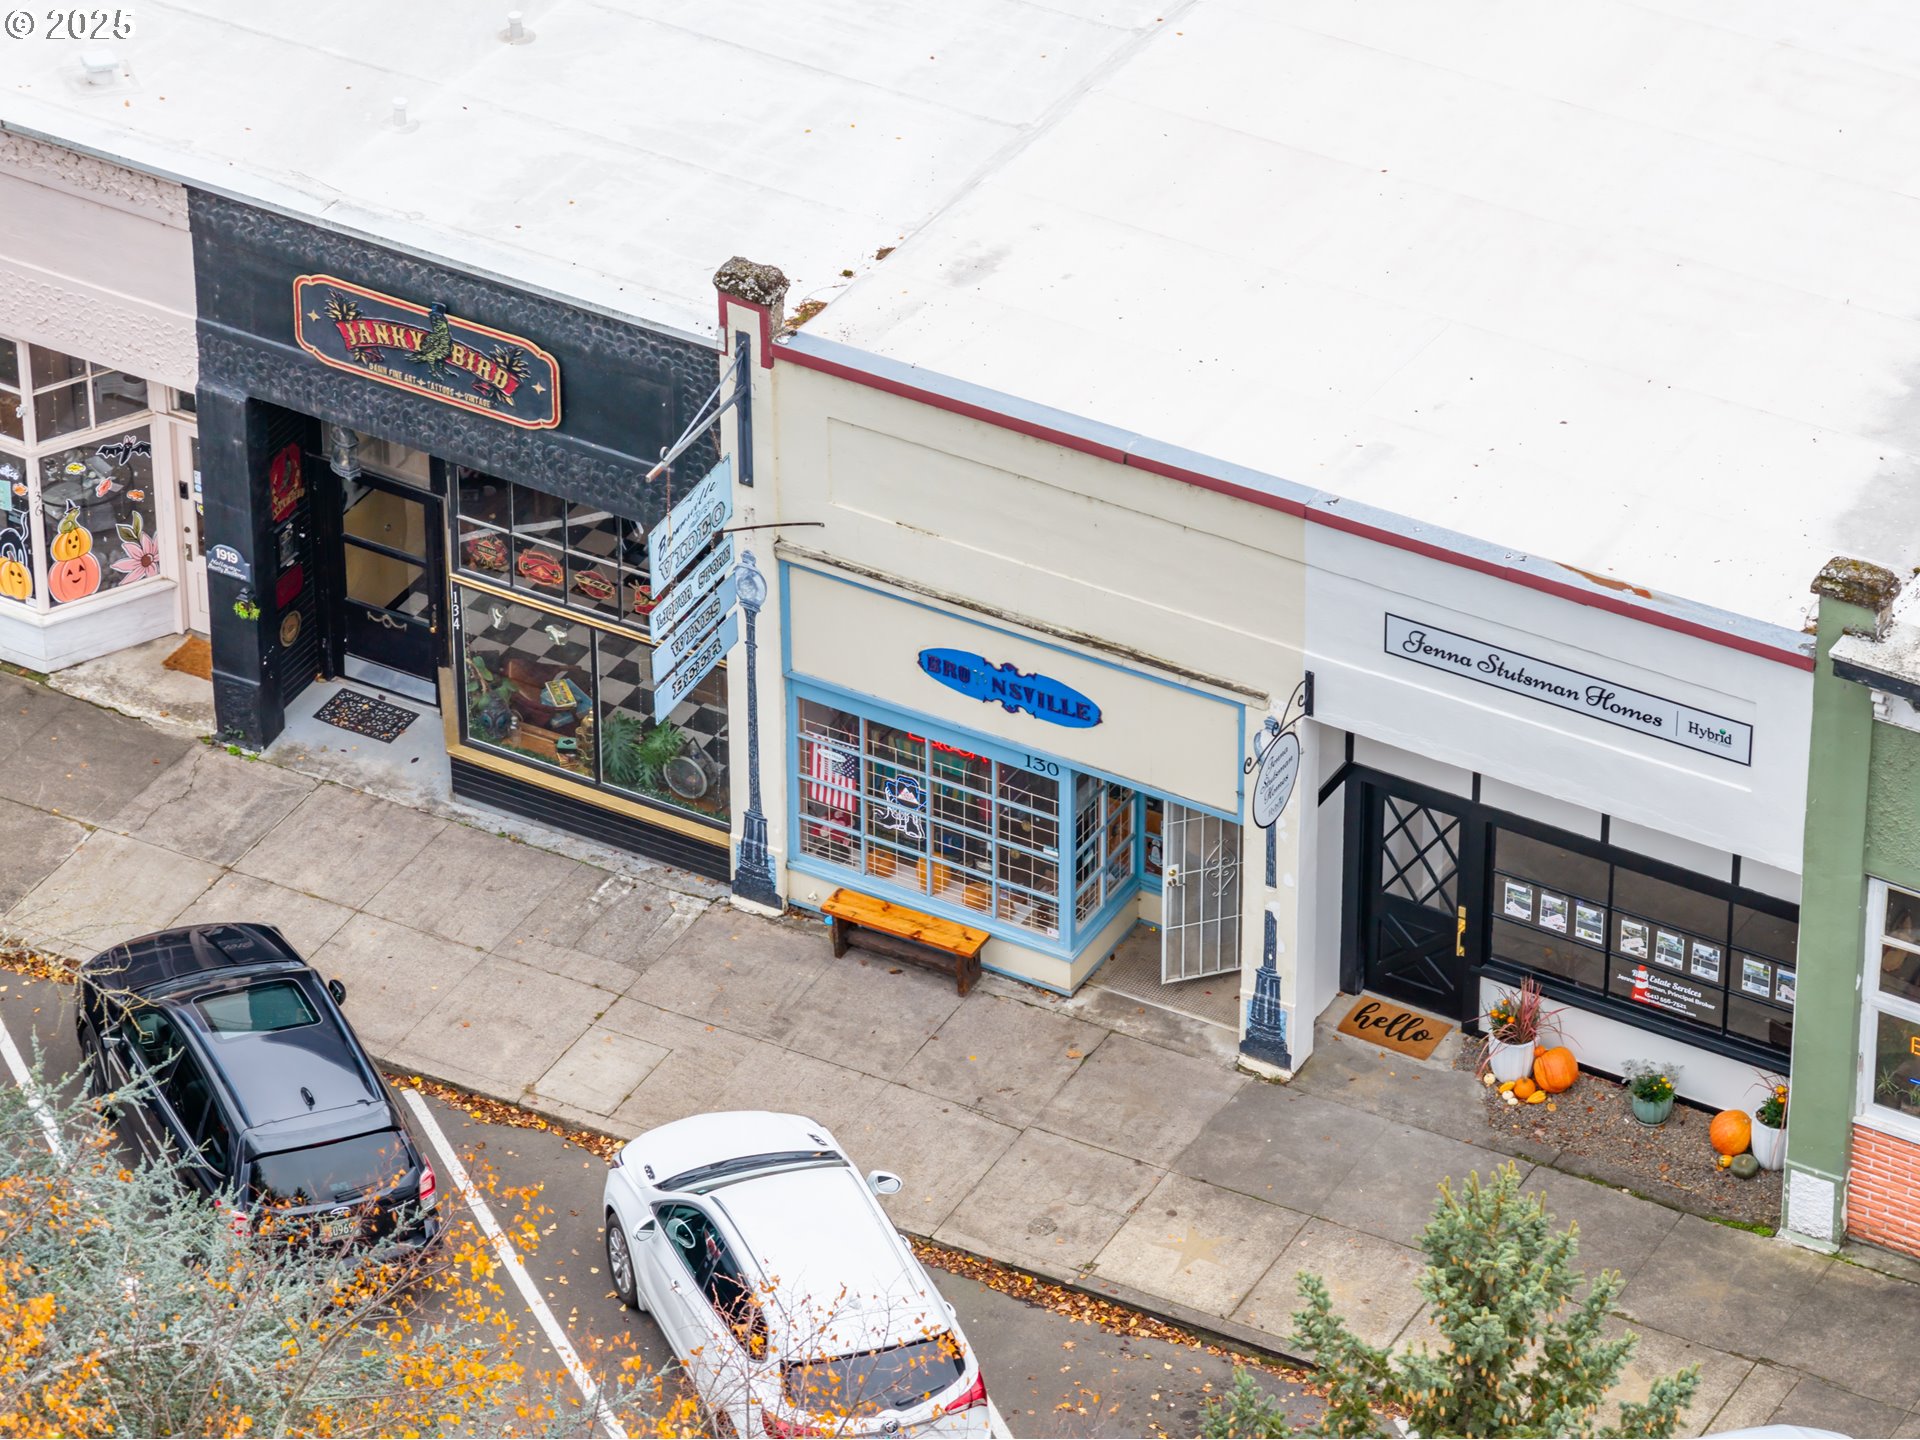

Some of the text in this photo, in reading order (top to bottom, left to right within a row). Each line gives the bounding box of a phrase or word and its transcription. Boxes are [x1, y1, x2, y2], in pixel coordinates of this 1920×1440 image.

[345, 321, 510, 389] JANKY BIRD
[404, 373, 417, 384] ART
[215, 548, 239, 564] 1919
[659, 501, 726, 580] VIDEO
[452, 591, 461, 630] 134
[655, 583, 693, 632] LIQUOR
[698, 543, 731, 590] STORE
[670, 597, 722, 657] WINES
[672, 637, 722, 700] BEER
[926, 654, 1092, 722] BRONSVILLE
[1402, 630, 1732, 746] Jenna Stutsman Homes Hybrid
[1024, 754, 1060, 778] 130
[1650, 975, 1671, 988] Estate
[1672, 982, 1702, 998] Services
[1353, 1002, 1434, 1042] hello
